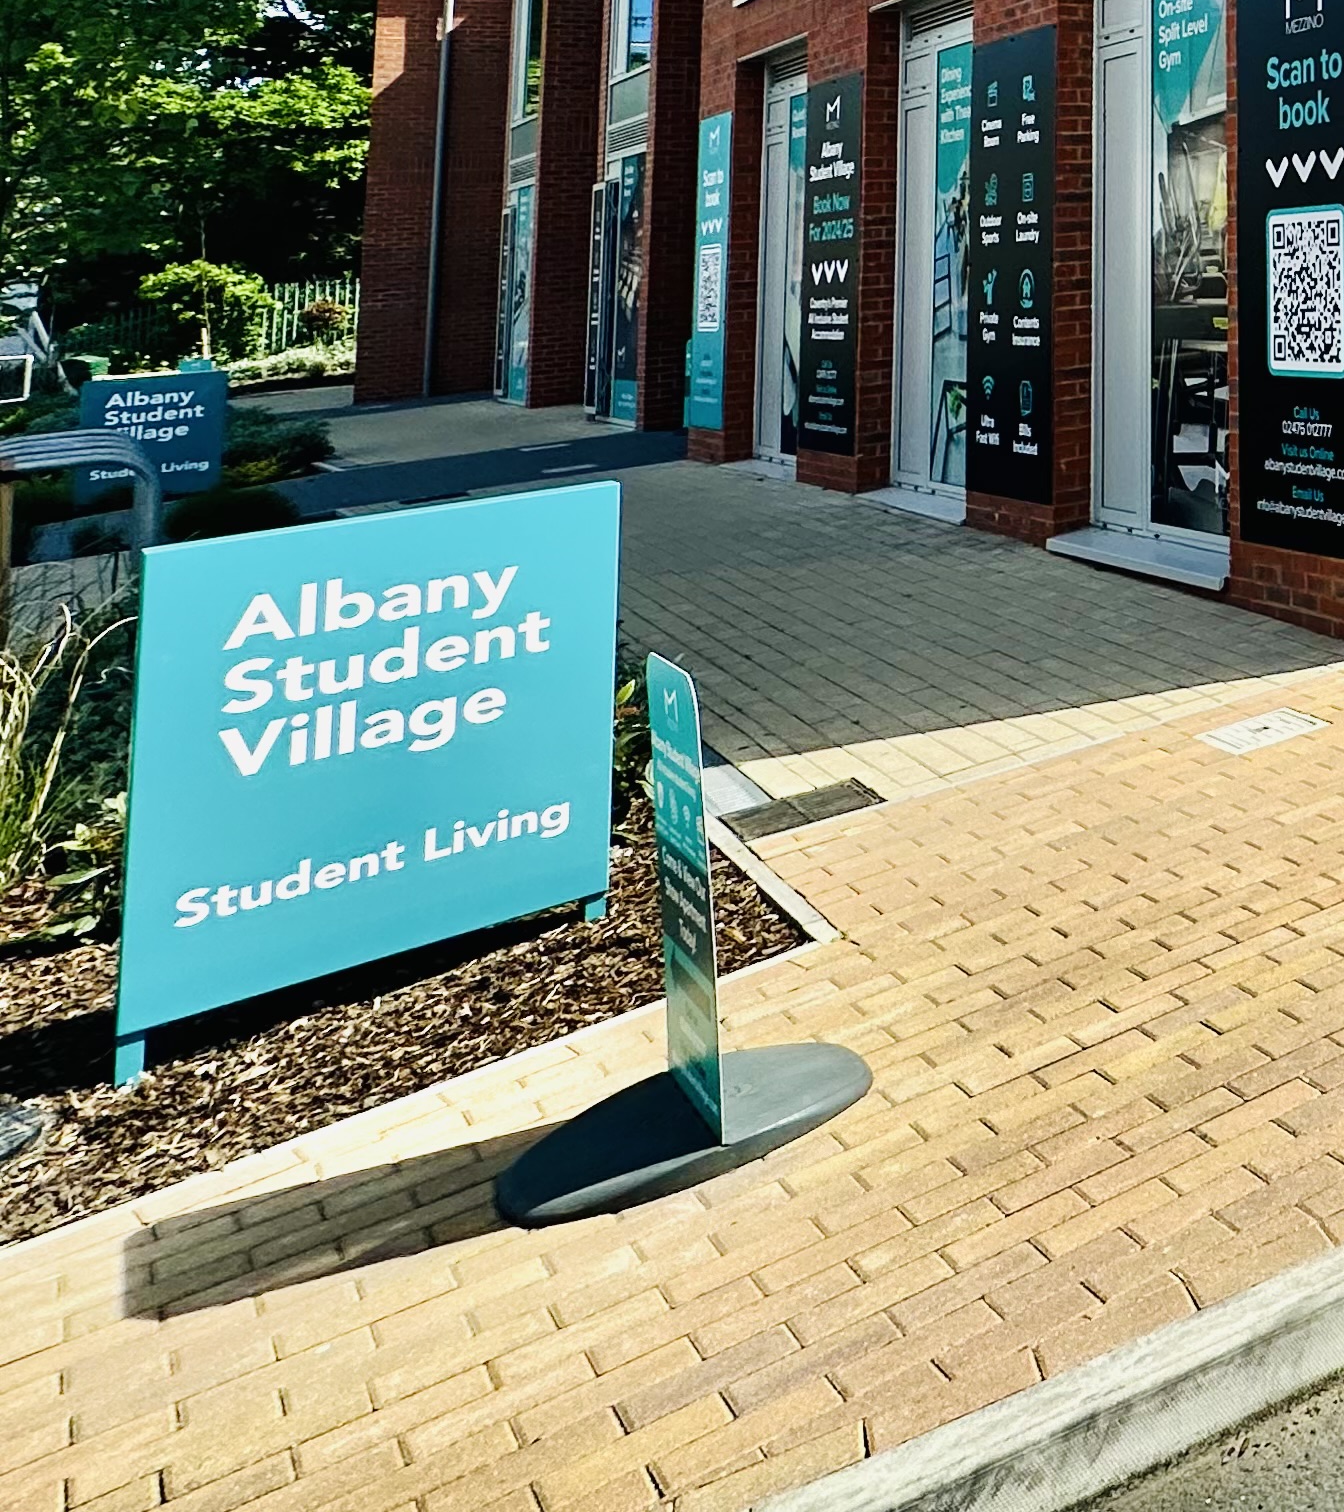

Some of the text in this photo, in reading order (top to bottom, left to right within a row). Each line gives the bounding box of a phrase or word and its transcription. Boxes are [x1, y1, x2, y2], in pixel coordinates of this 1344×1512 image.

[1158, 12, 1208, 47] Split Level
[1285, 13, 1324, 35] MEZZINO
[1158, 50, 1181, 73] Gym
[1266, 48, 1343, 90] Scan to
[1278, 89, 1331, 130] book
[813, 192, 850, 215] Book Now
[808, 218, 854, 242] For 2024/25
[104, 390, 196, 409] Albany
[103, 405, 206, 426] Student
[1293, 406, 1320, 420] Call Us
[117, 424, 190, 442] llage
[1281, 443, 1298, 457] Visit
[1309, 445, 1335, 461] Online
[88, 460, 210, 481] Stude Living
[1292, 485, 1324, 502] Email Us
[221, 564, 519, 652] Albany
[220, 610, 552, 714] Student
[217, 686, 508, 778] Village
[172, 840, 405, 929] Student
[423, 801, 571, 862] Living
